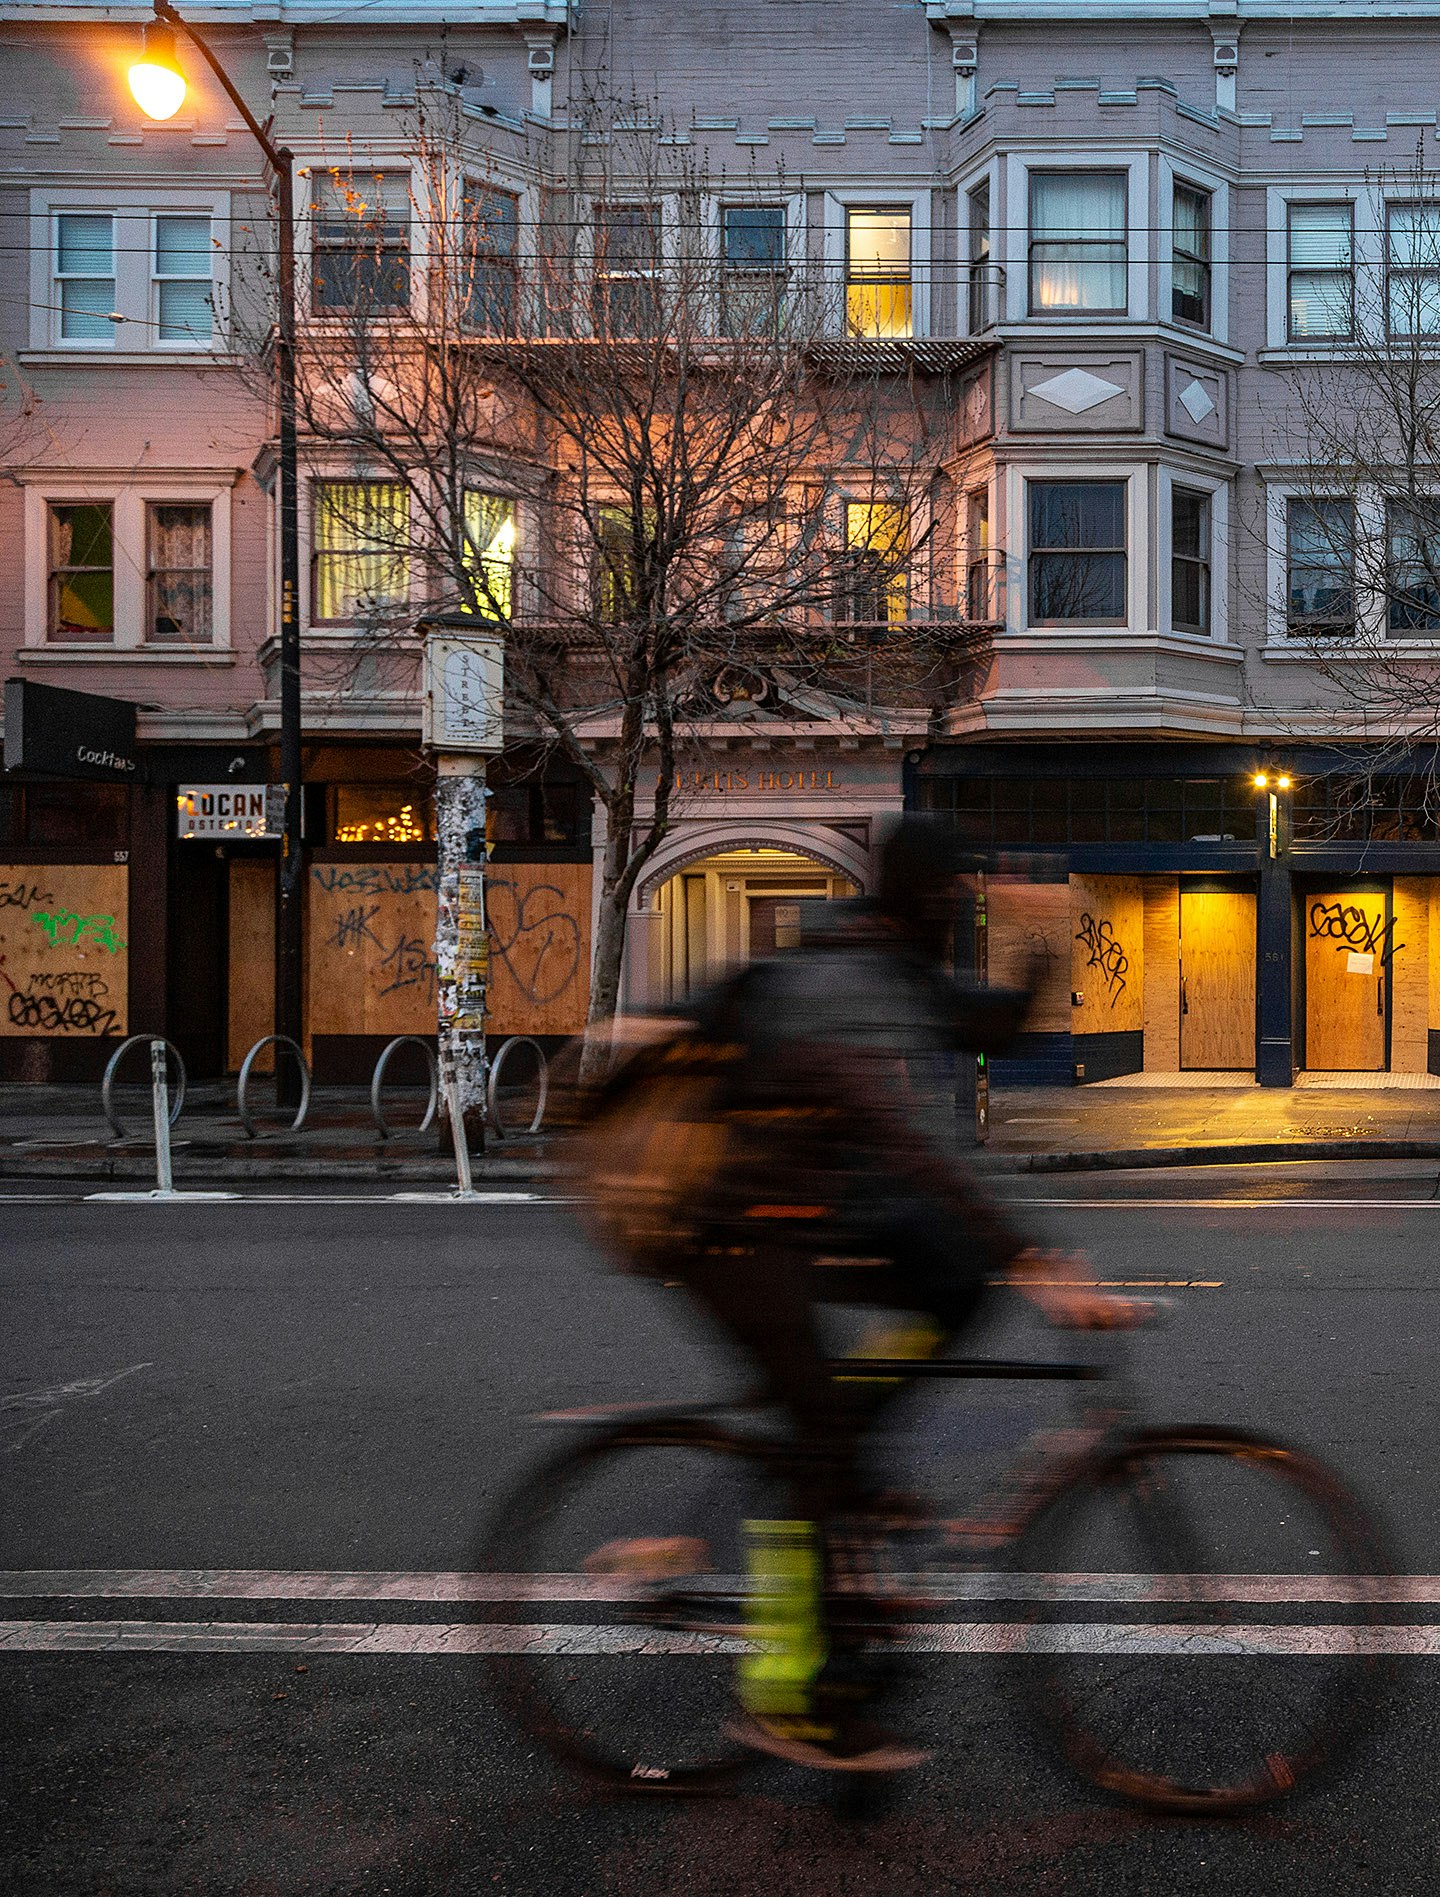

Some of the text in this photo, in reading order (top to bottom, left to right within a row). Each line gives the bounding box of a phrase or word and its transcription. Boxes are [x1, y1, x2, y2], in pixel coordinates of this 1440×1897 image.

[656, 770, 842, 790] URTIS HOTEL
[186, 793, 263, 817] LOCAN
